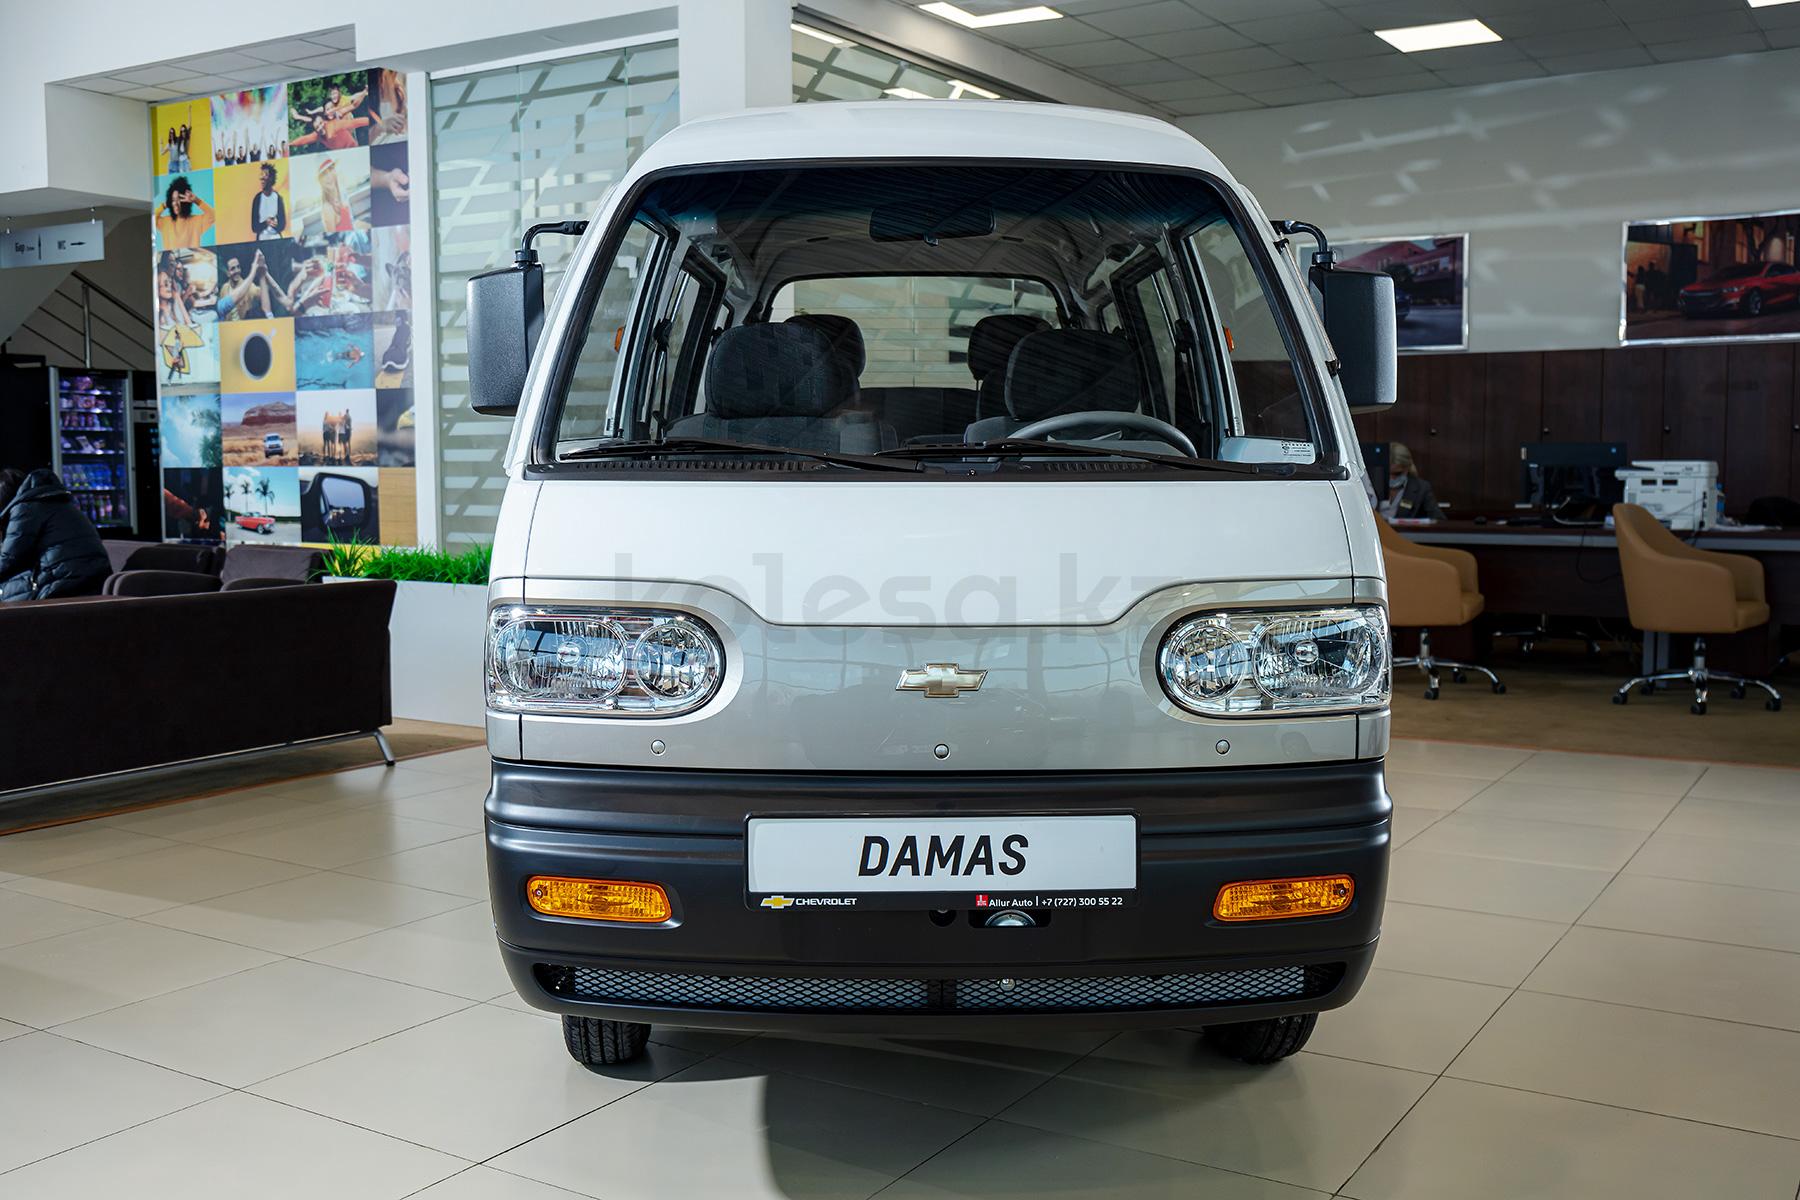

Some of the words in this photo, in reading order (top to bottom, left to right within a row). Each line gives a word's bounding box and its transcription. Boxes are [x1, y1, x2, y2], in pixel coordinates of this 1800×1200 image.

[858, 834, 1029, 877] DAMAS
[795, 898, 858, 906] CHEVROLET
[988, 898, 1010, 907] Allur
[1011, 898, 1033, 907] Auto
[1041, 898, 1053, 907] +7
[1054, 897, 1077, 907] (727)
[1079, 897, 1097, 906] 300
[1098, 897, 1110, 906] 55
[1111, 897, 1123, 906] 22
